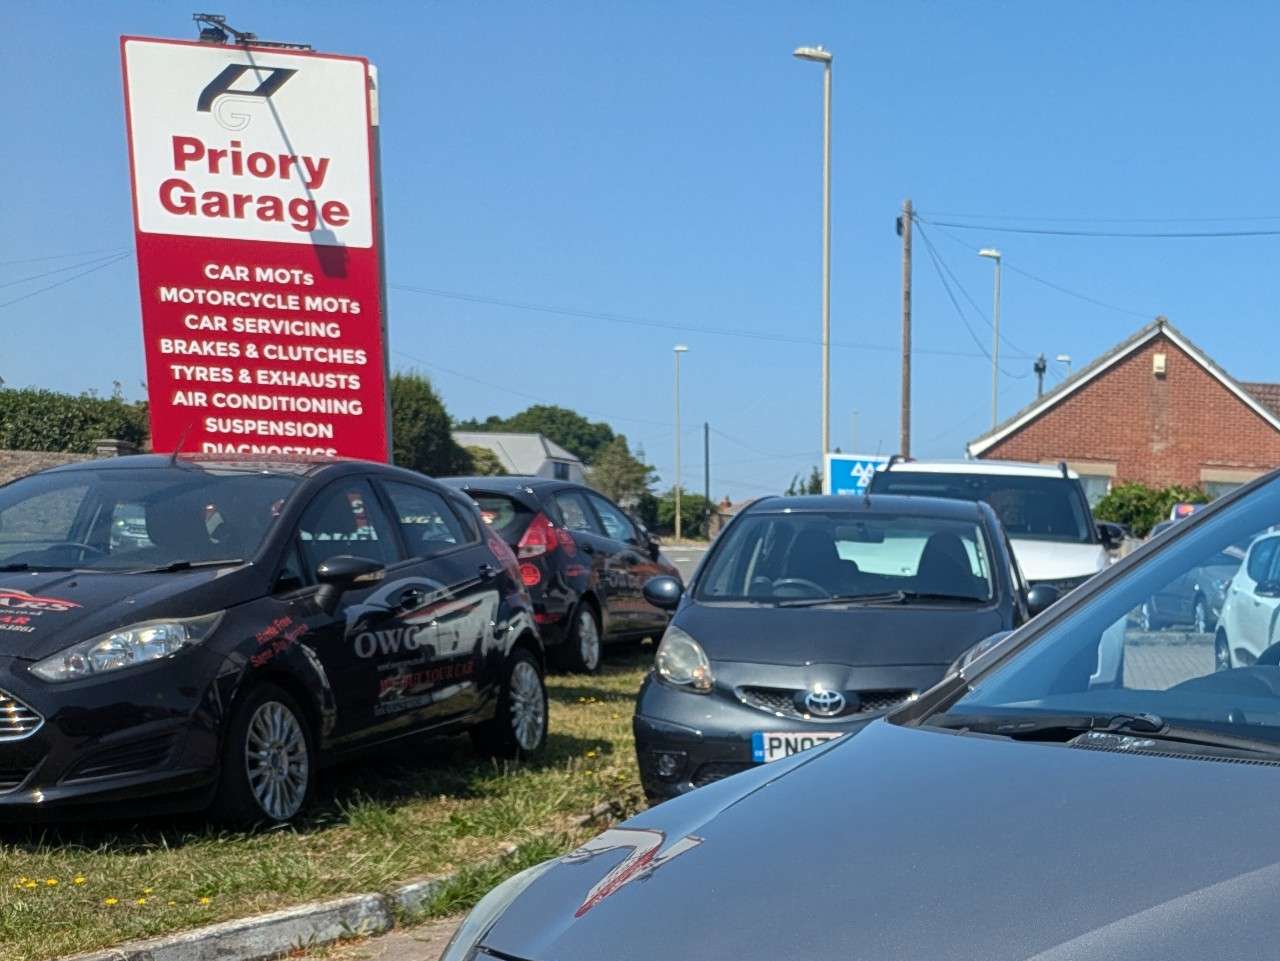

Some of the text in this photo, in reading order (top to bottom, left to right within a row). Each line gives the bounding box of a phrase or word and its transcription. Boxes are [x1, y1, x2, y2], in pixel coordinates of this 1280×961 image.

[172, 135, 330, 190] Priory
[159, 178, 350, 232] Garage
[204, 263, 315, 286] CAR MOTs
[160, 286, 361, 315] MOTORCYCLE MOTs
[184, 313, 341, 339] CAR SERVICING
[160, 338, 368, 365] BRAKES & CLUTCHES
[171, 365, 361, 390] TYRES & EXHAUSTS
[172, 390, 363, 416] AIR CONDITIONING
[205, 417, 333, 438] SUSPENSION
